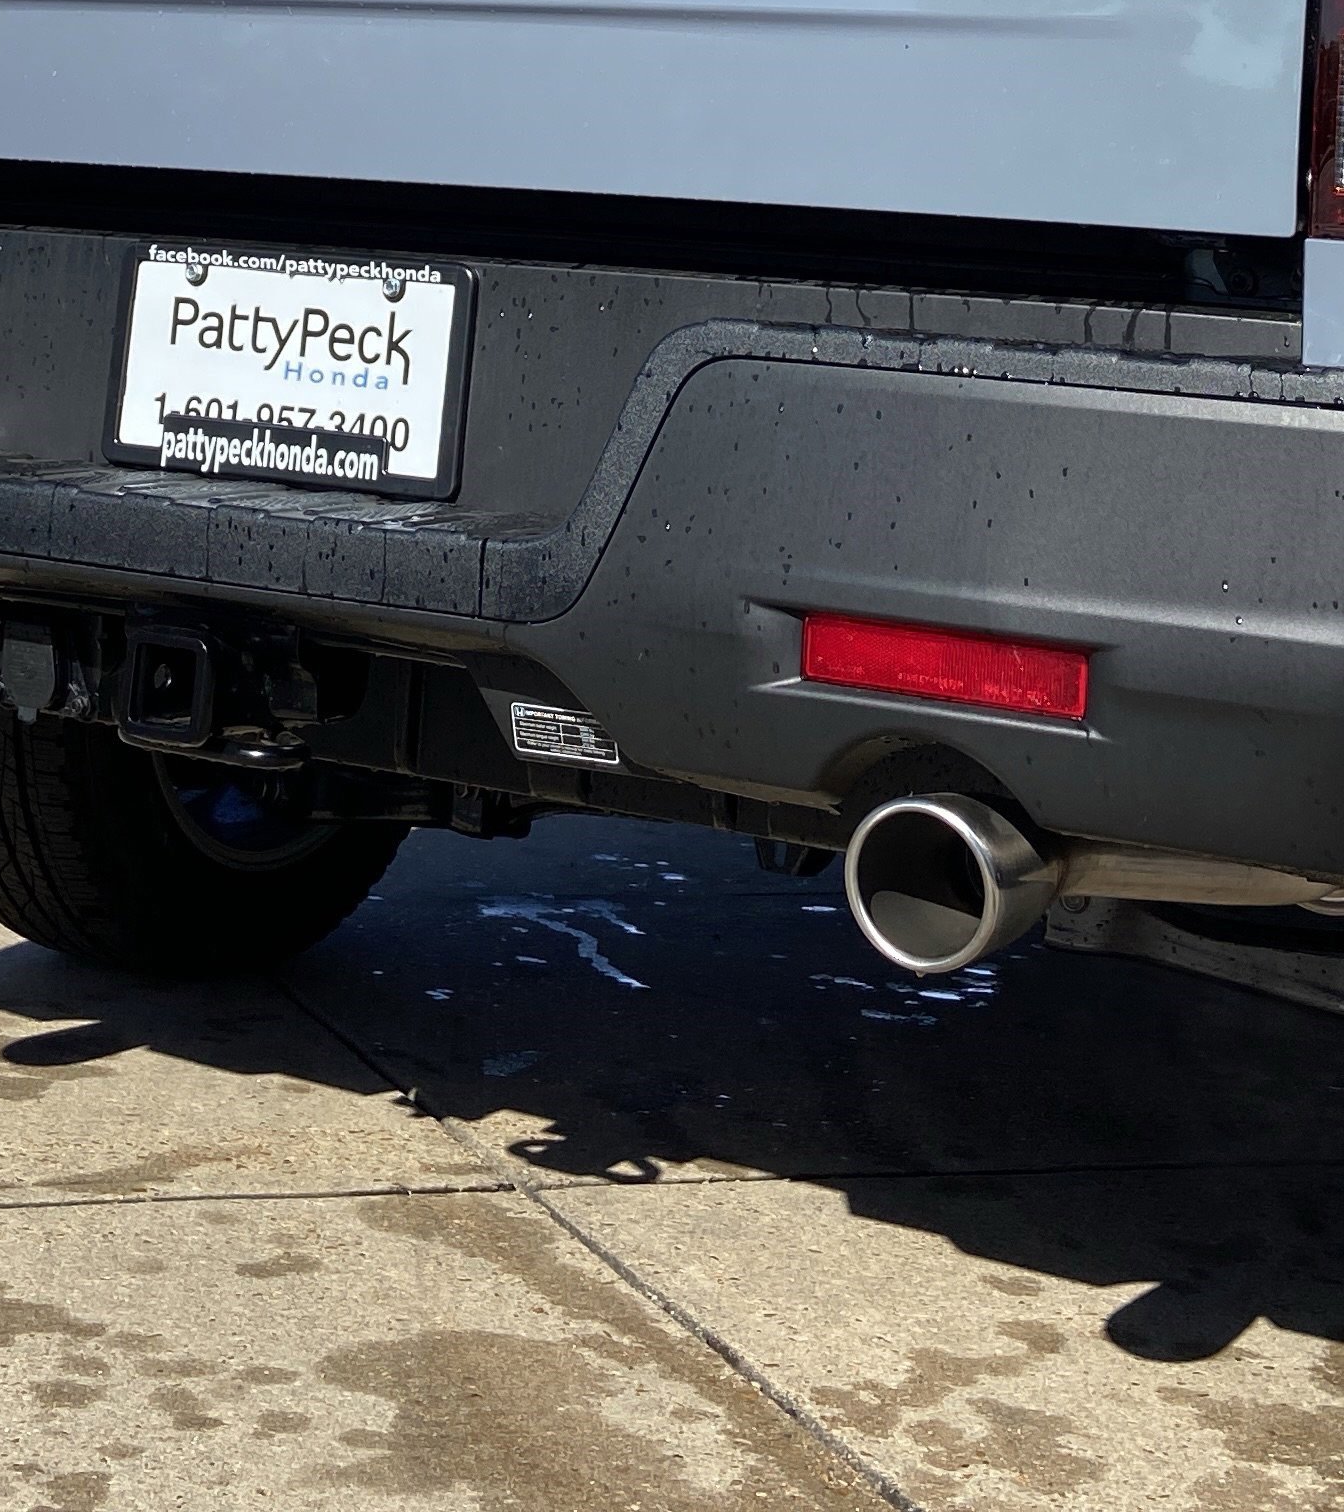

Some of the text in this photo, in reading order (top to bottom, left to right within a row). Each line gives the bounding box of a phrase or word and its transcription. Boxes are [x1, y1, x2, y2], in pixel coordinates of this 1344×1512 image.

[147, 244, 442, 283] facebook.com/pattypeckhonda
[169, 296, 414, 386] PattyPeck
[283, 360, 390, 391] Honda
[159, 427, 379, 481] pattypeckhonda.com
